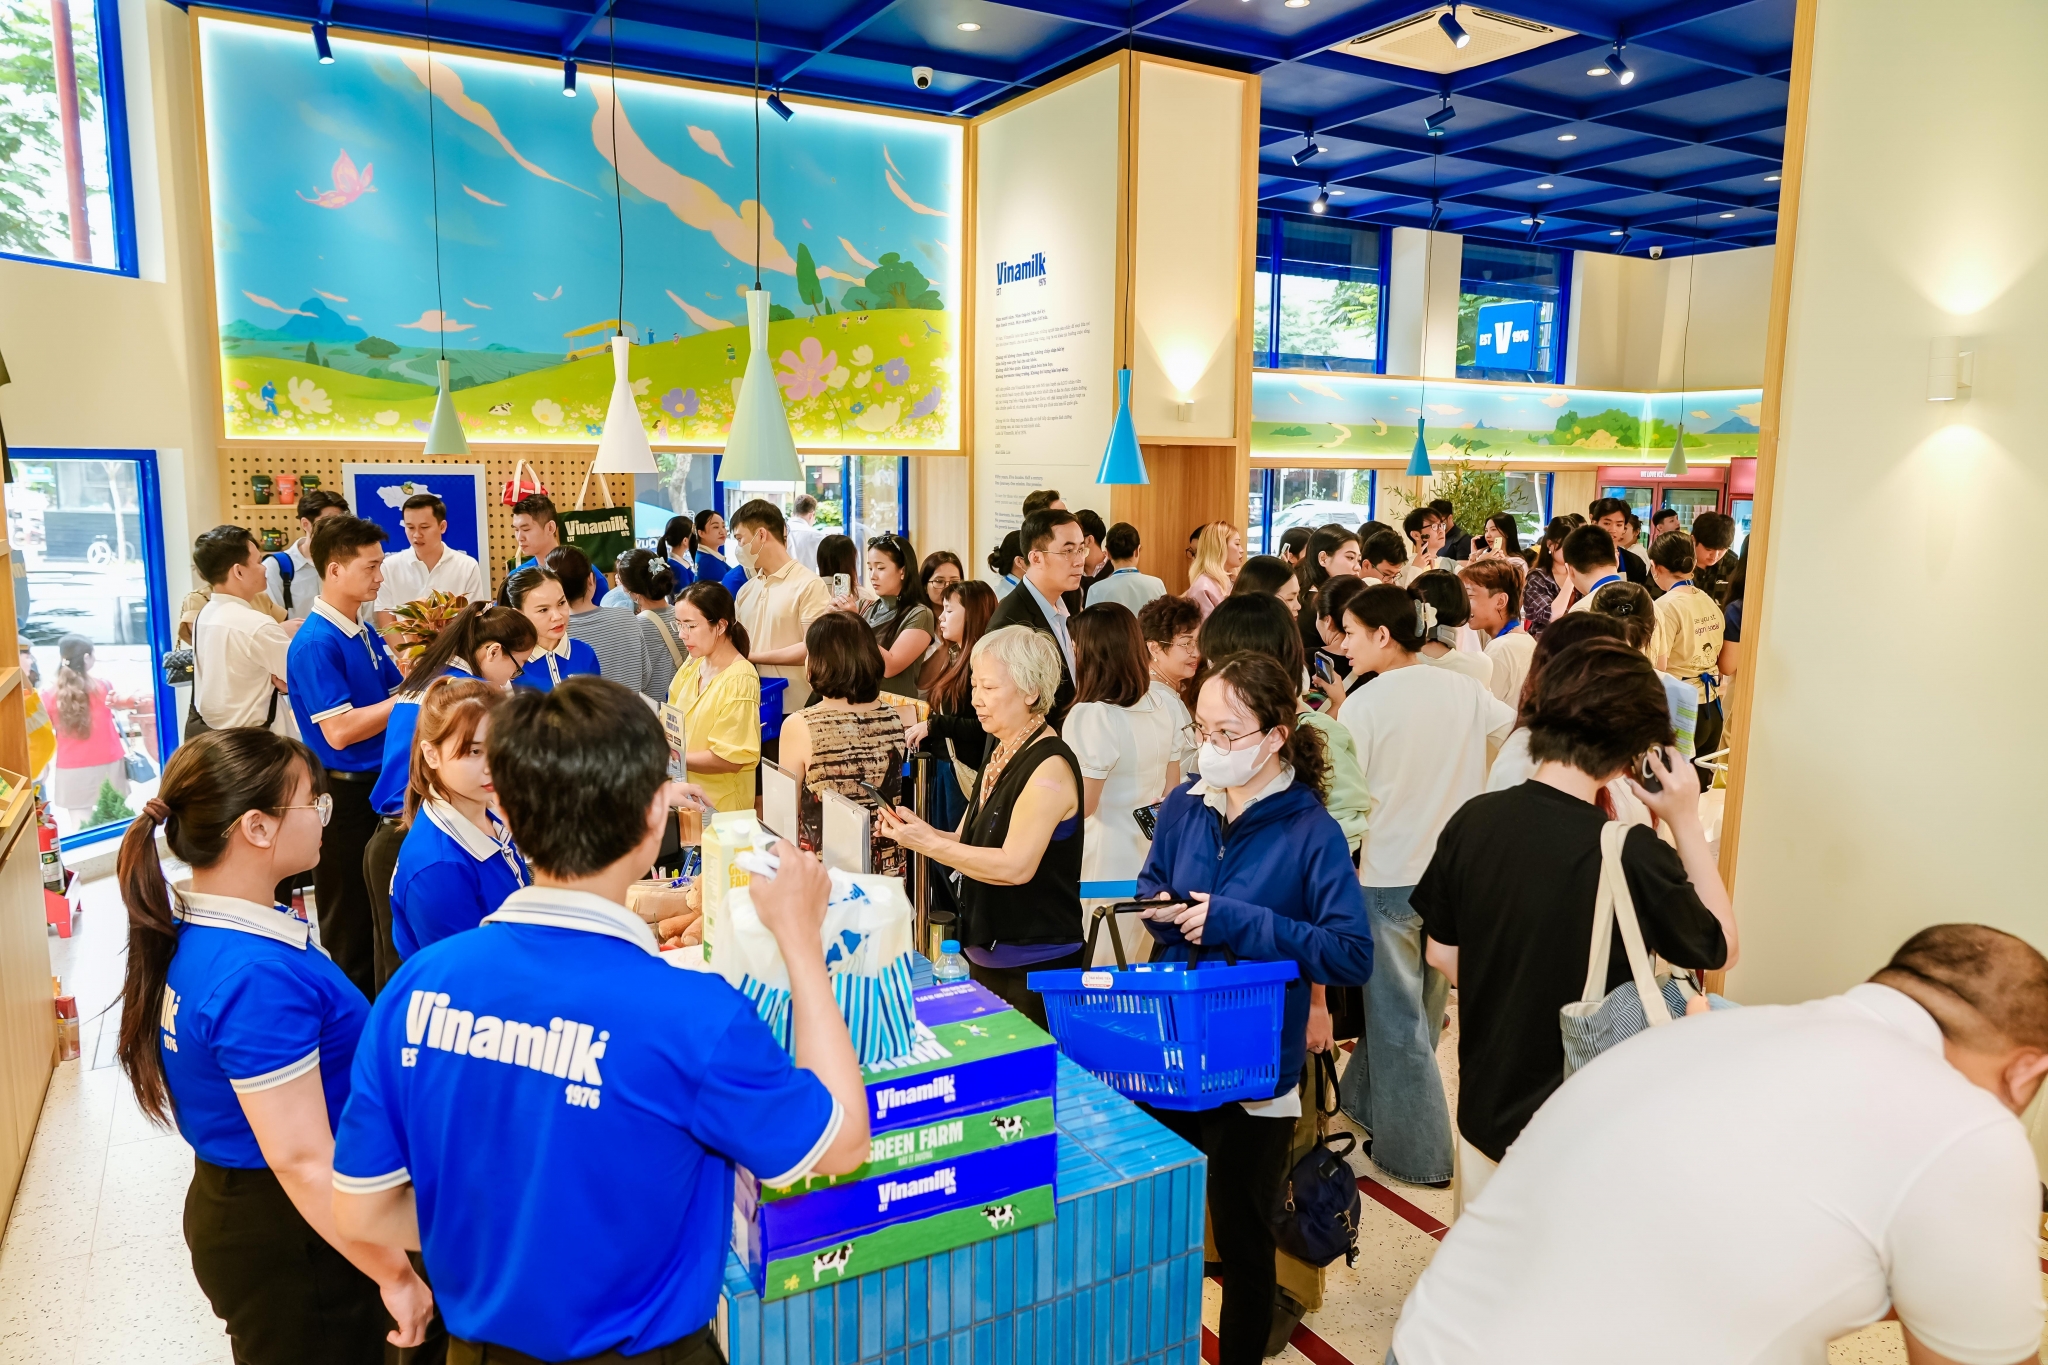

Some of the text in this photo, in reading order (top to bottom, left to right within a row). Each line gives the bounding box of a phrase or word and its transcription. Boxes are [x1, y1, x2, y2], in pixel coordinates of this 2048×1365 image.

[997, 252, 1046, 285] Vinamilk
[1479, 321, 1529, 354] EST V 1976
[565, 515, 629, 536] Vinamilk
[164, 1033, 178, 1052] 1976
[406, 990, 608, 1086] Vinamilk
[565, 1084, 600, 1110] 1976
[876, 1075, 956, 1110] Vinamilk
[919, 1121, 963, 1151] FARM
[878, 1167, 956, 1204] Vinamilk
